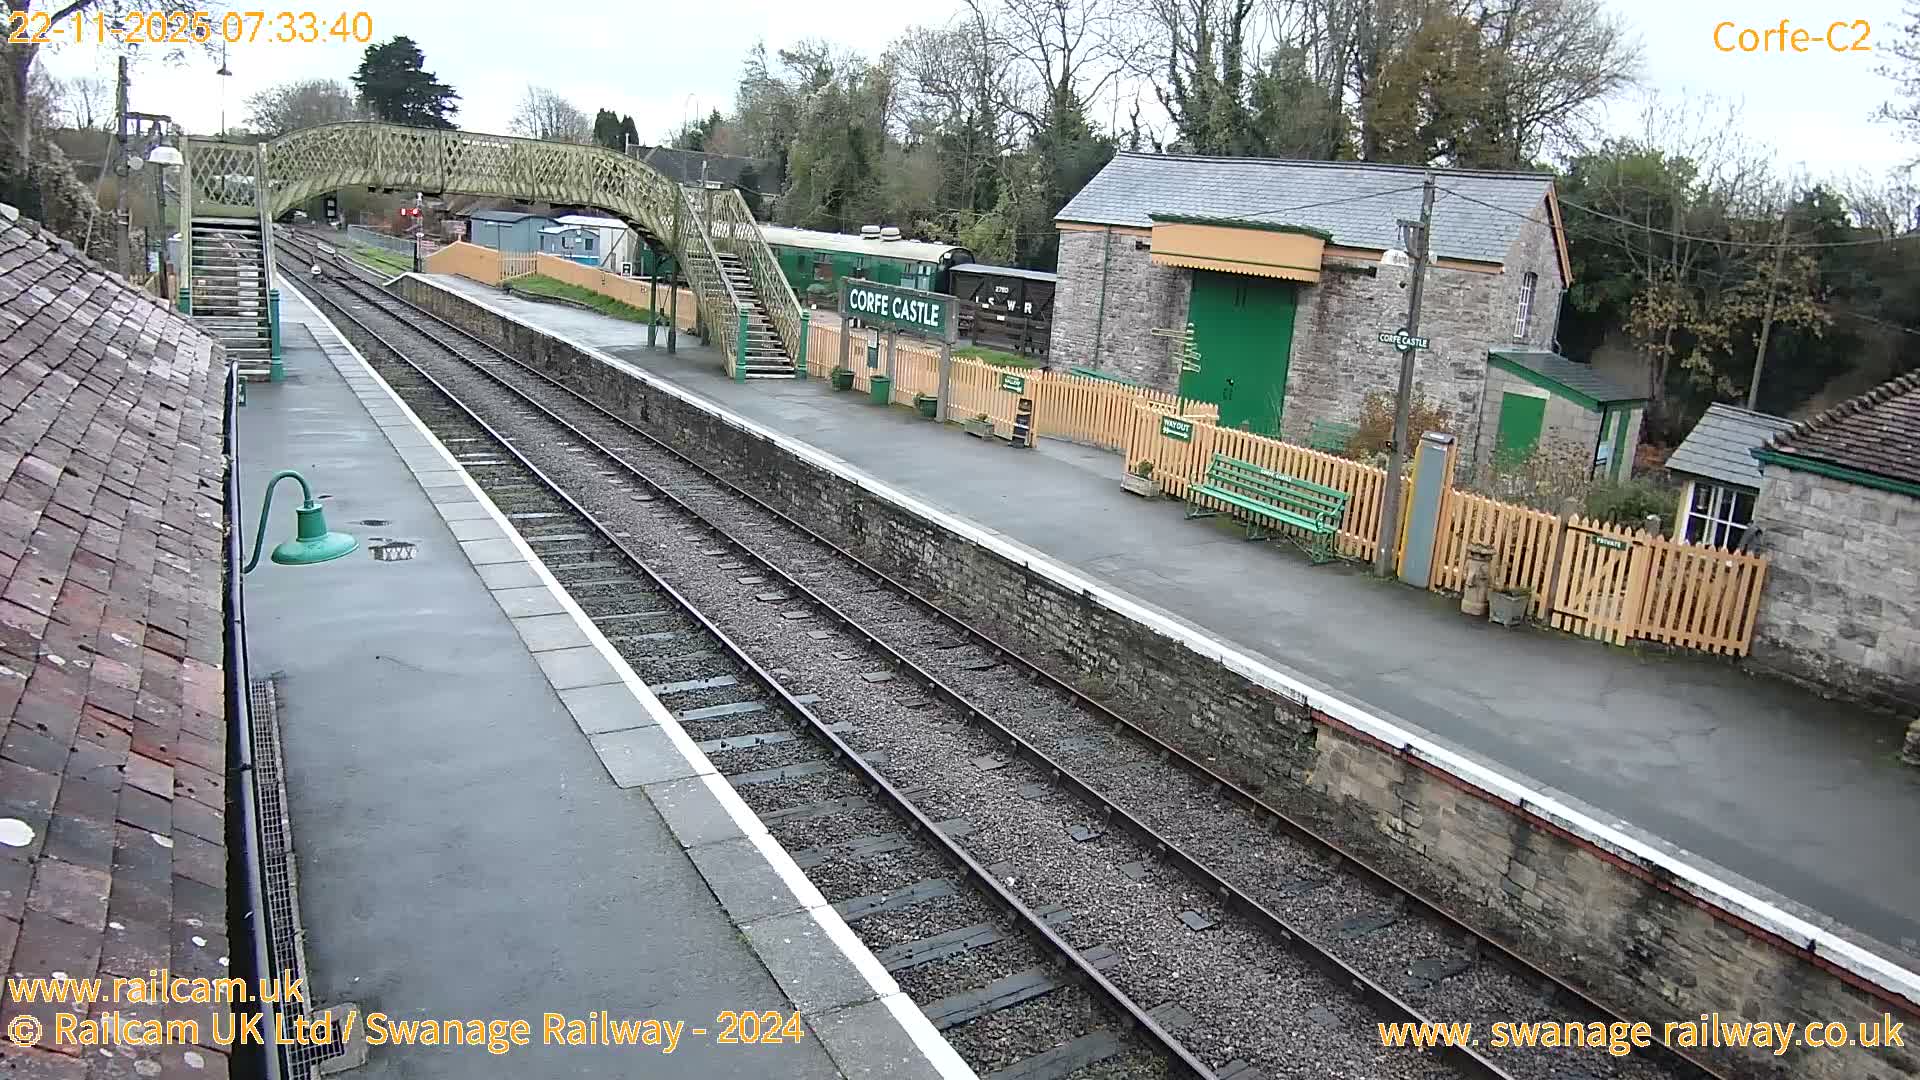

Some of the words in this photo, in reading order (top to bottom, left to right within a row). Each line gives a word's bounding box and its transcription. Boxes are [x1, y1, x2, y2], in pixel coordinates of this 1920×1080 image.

[850, 288, 889, 316] CORFE
[892, 297, 939, 327] CASTLE
[1380, 333, 1400, 344] CORFE
[1402, 336, 1428, 347] CASTLE
[1163, 418, 1177, 428] WAY
[1176, 423, 1189, 431] OUT
